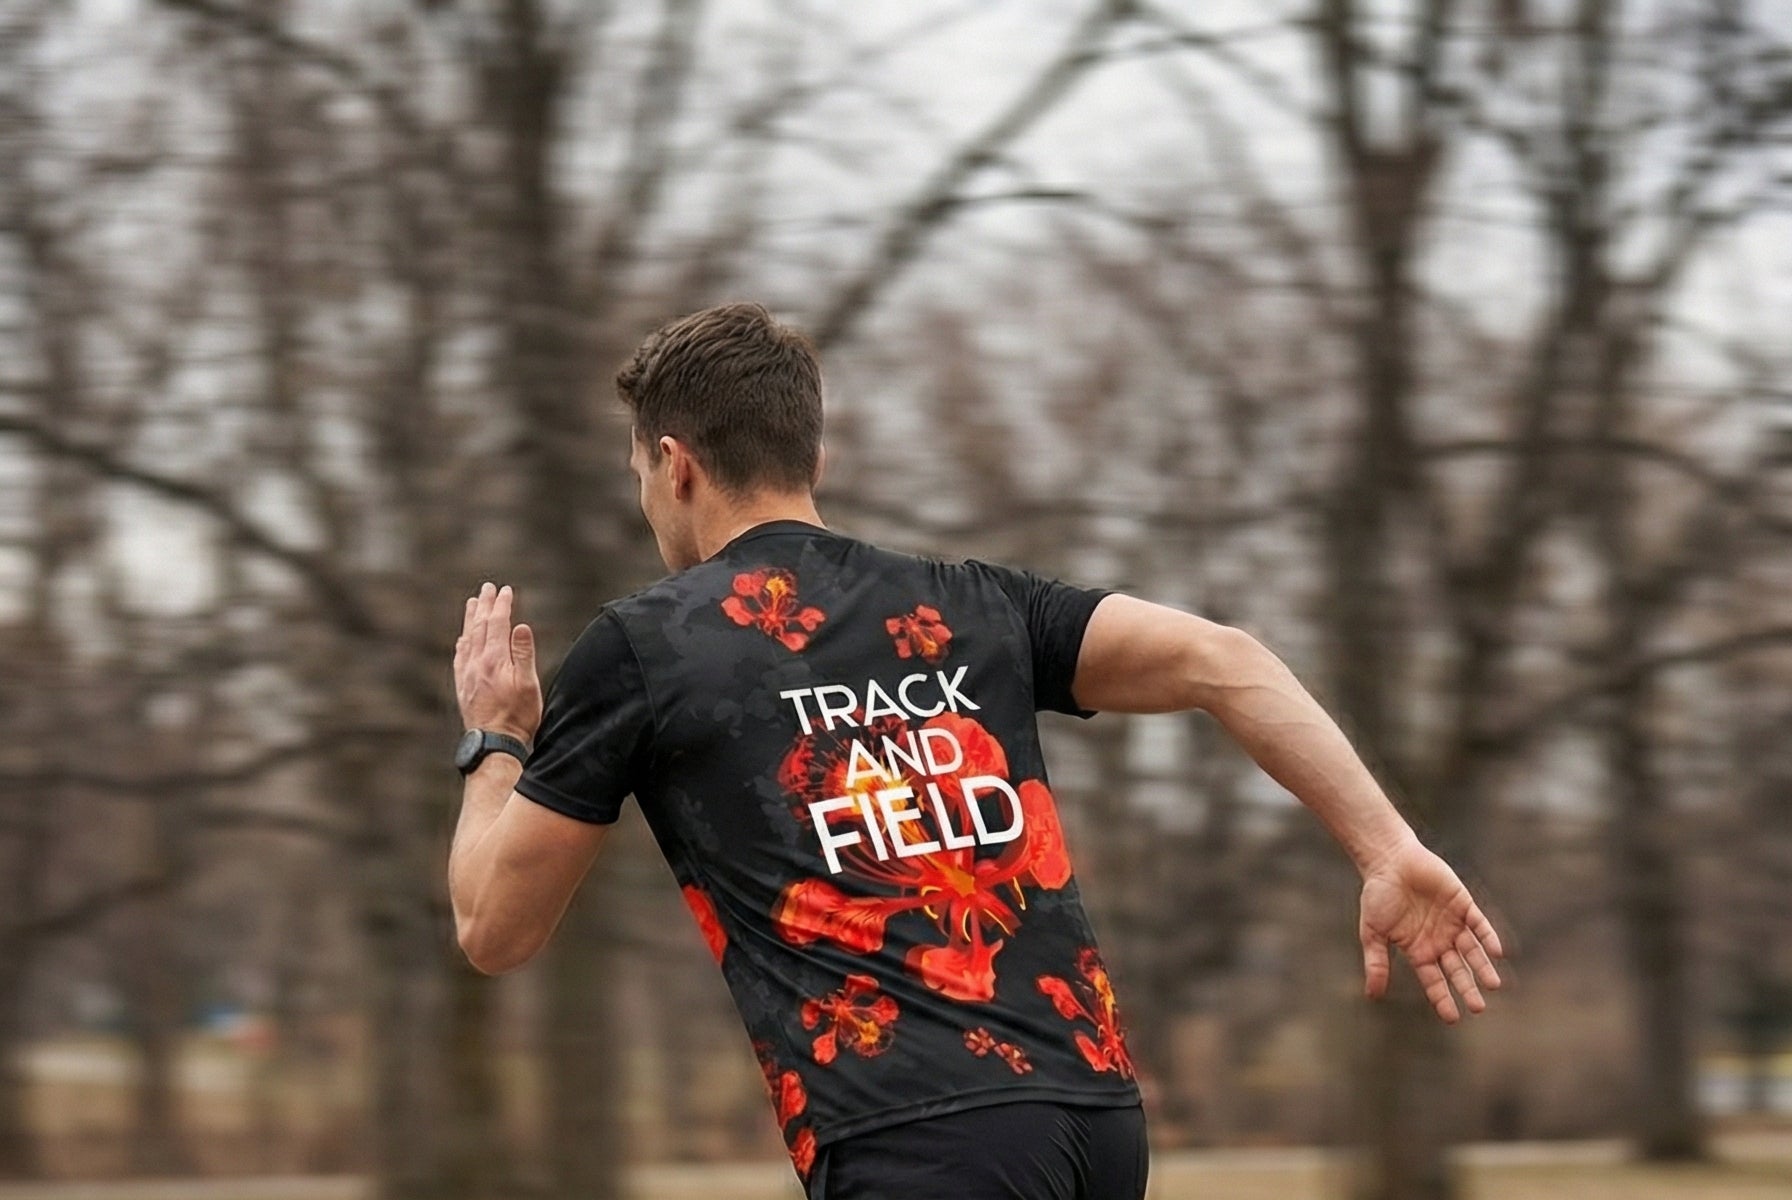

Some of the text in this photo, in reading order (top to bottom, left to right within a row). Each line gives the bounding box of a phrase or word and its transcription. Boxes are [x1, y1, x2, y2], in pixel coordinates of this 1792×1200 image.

[780, 665, 981, 735] TRACK
[846, 728, 963, 788] AND
[808, 775, 1024, 874] FIELD
